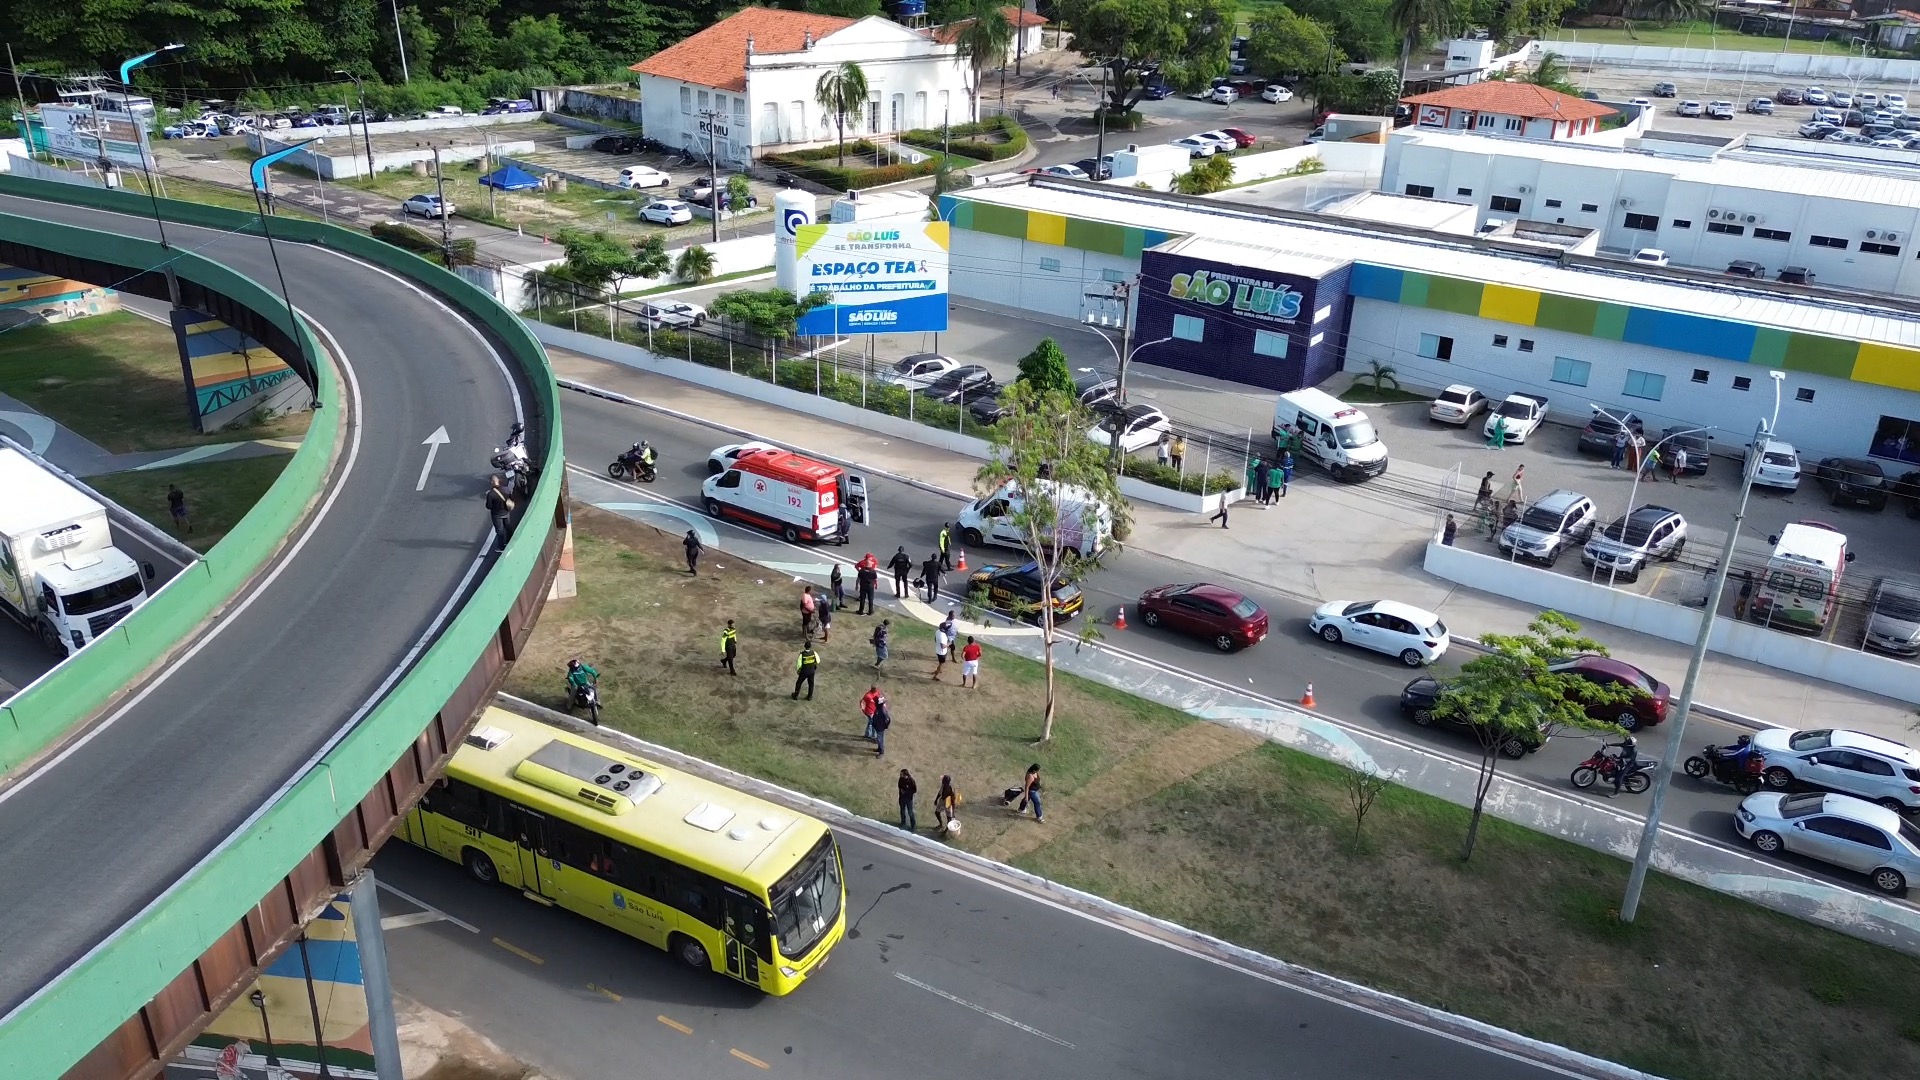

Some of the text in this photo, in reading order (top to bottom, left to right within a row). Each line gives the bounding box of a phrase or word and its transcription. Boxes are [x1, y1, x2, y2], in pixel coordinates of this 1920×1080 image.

[700, 121, 728, 136] ROMU
[847, 227, 900, 242] SÃO LUÍS
[848, 242, 912, 250] TRANSFORMA
[812, 260, 916, 278] ESPAÇO TEA
[863, 283, 876, 291] DA
[876, 282, 926, 290] PREFEITURA
[1211, 272, 1275, 289] PREFEITURA DE
[1168, 270, 1303, 319] SÃO LUÍS
[848, 309, 898, 322] SÃO LUÍS
[787, 495, 802, 508] 192
[464, 825, 484, 840] SIT
